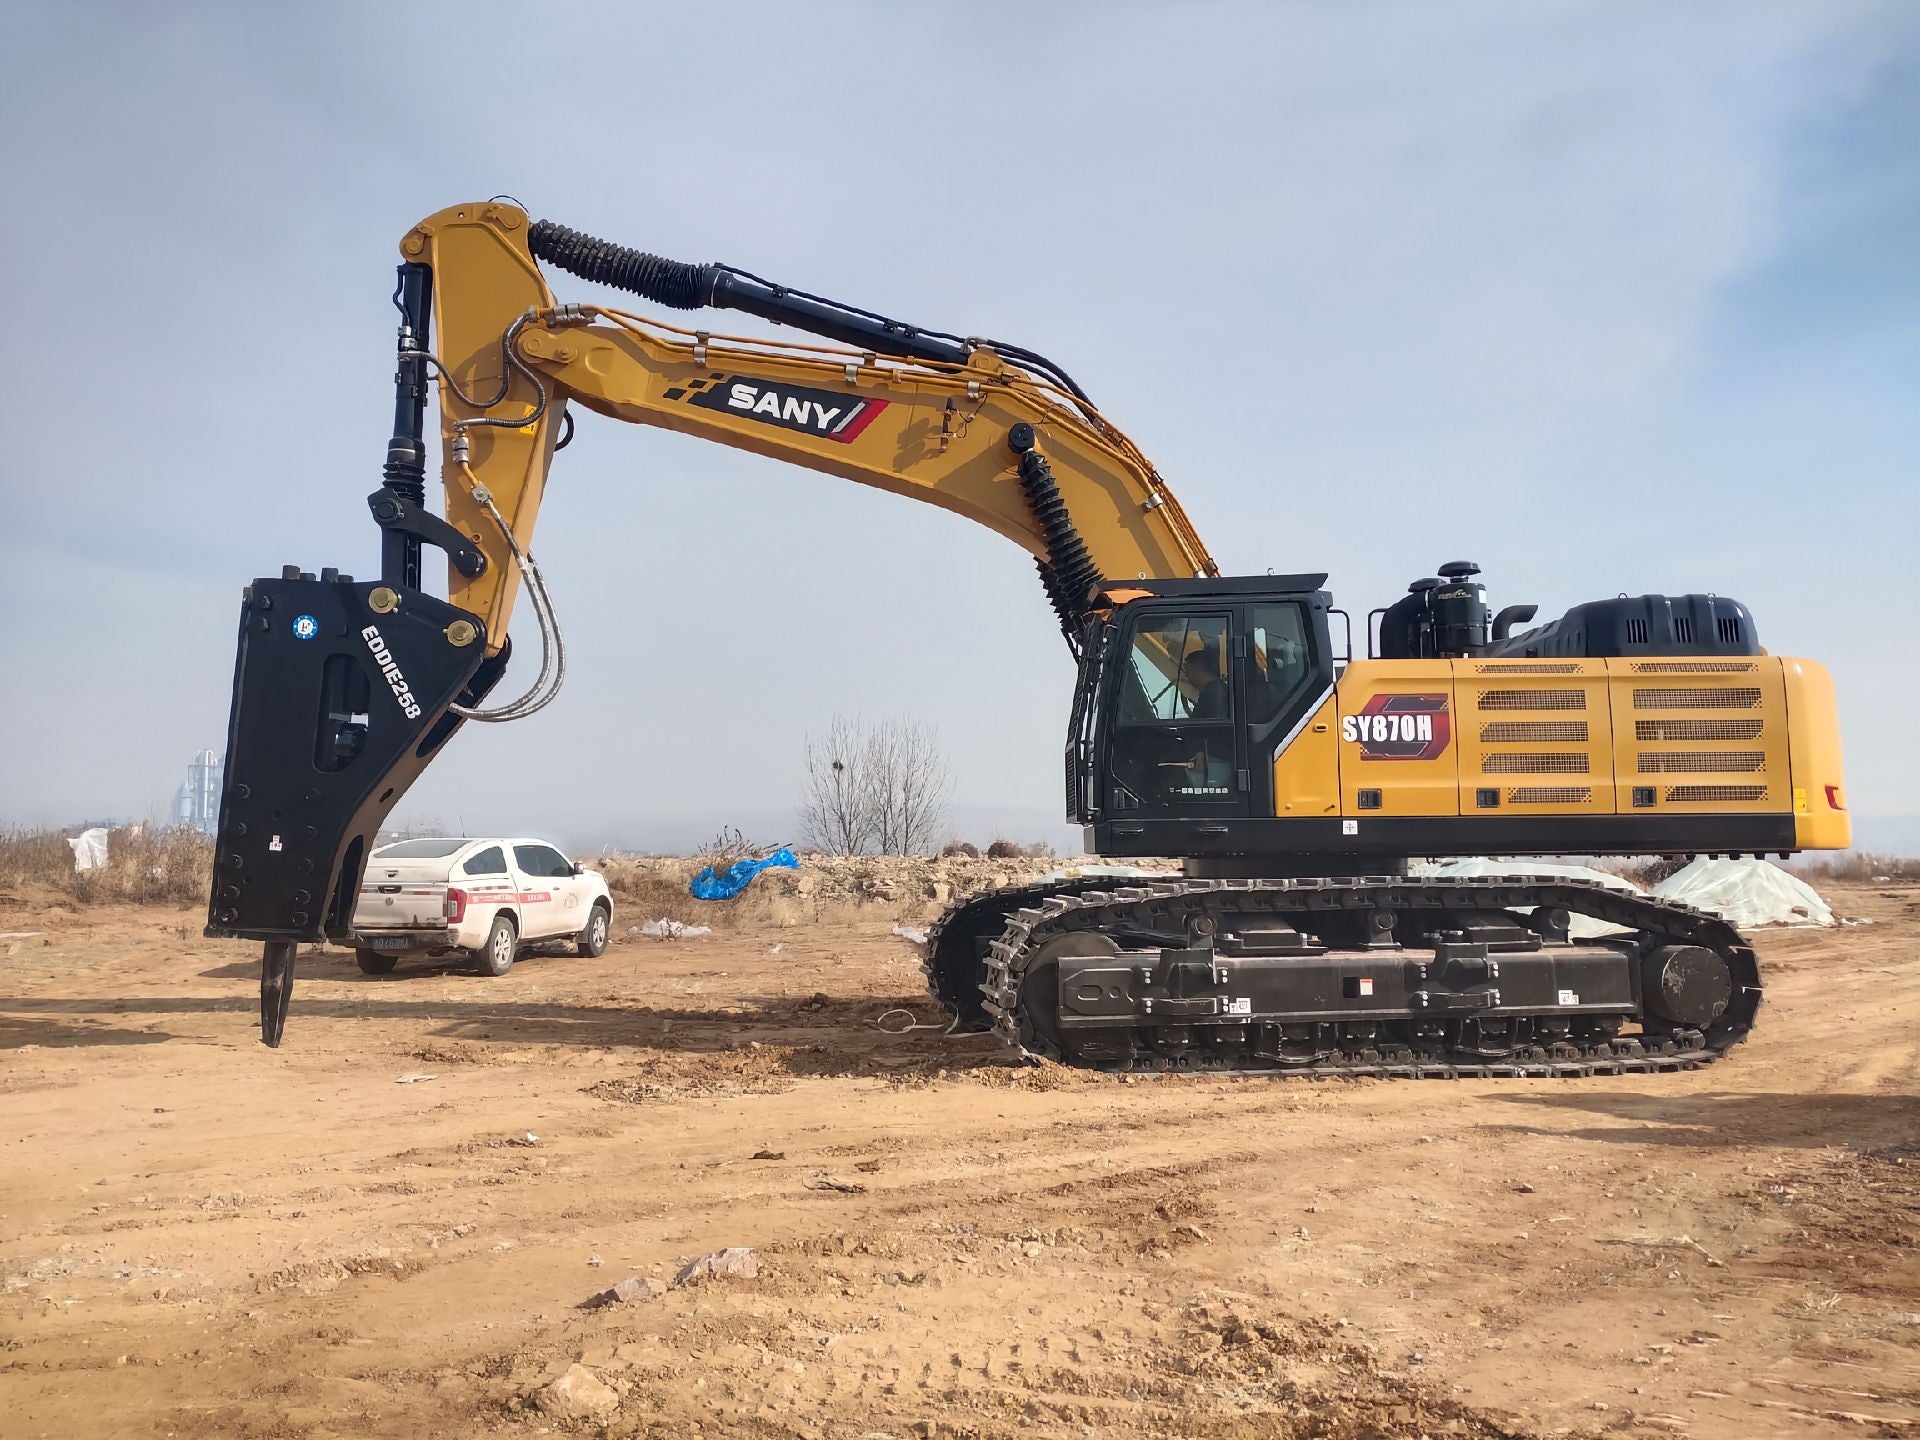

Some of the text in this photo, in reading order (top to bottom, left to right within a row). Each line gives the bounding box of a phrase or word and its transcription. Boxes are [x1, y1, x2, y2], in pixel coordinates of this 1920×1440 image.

[727, 383, 841, 430] SANY
[361, 624, 422, 719] EDDIE258
[1342, 714, 1433, 742] SY870H
